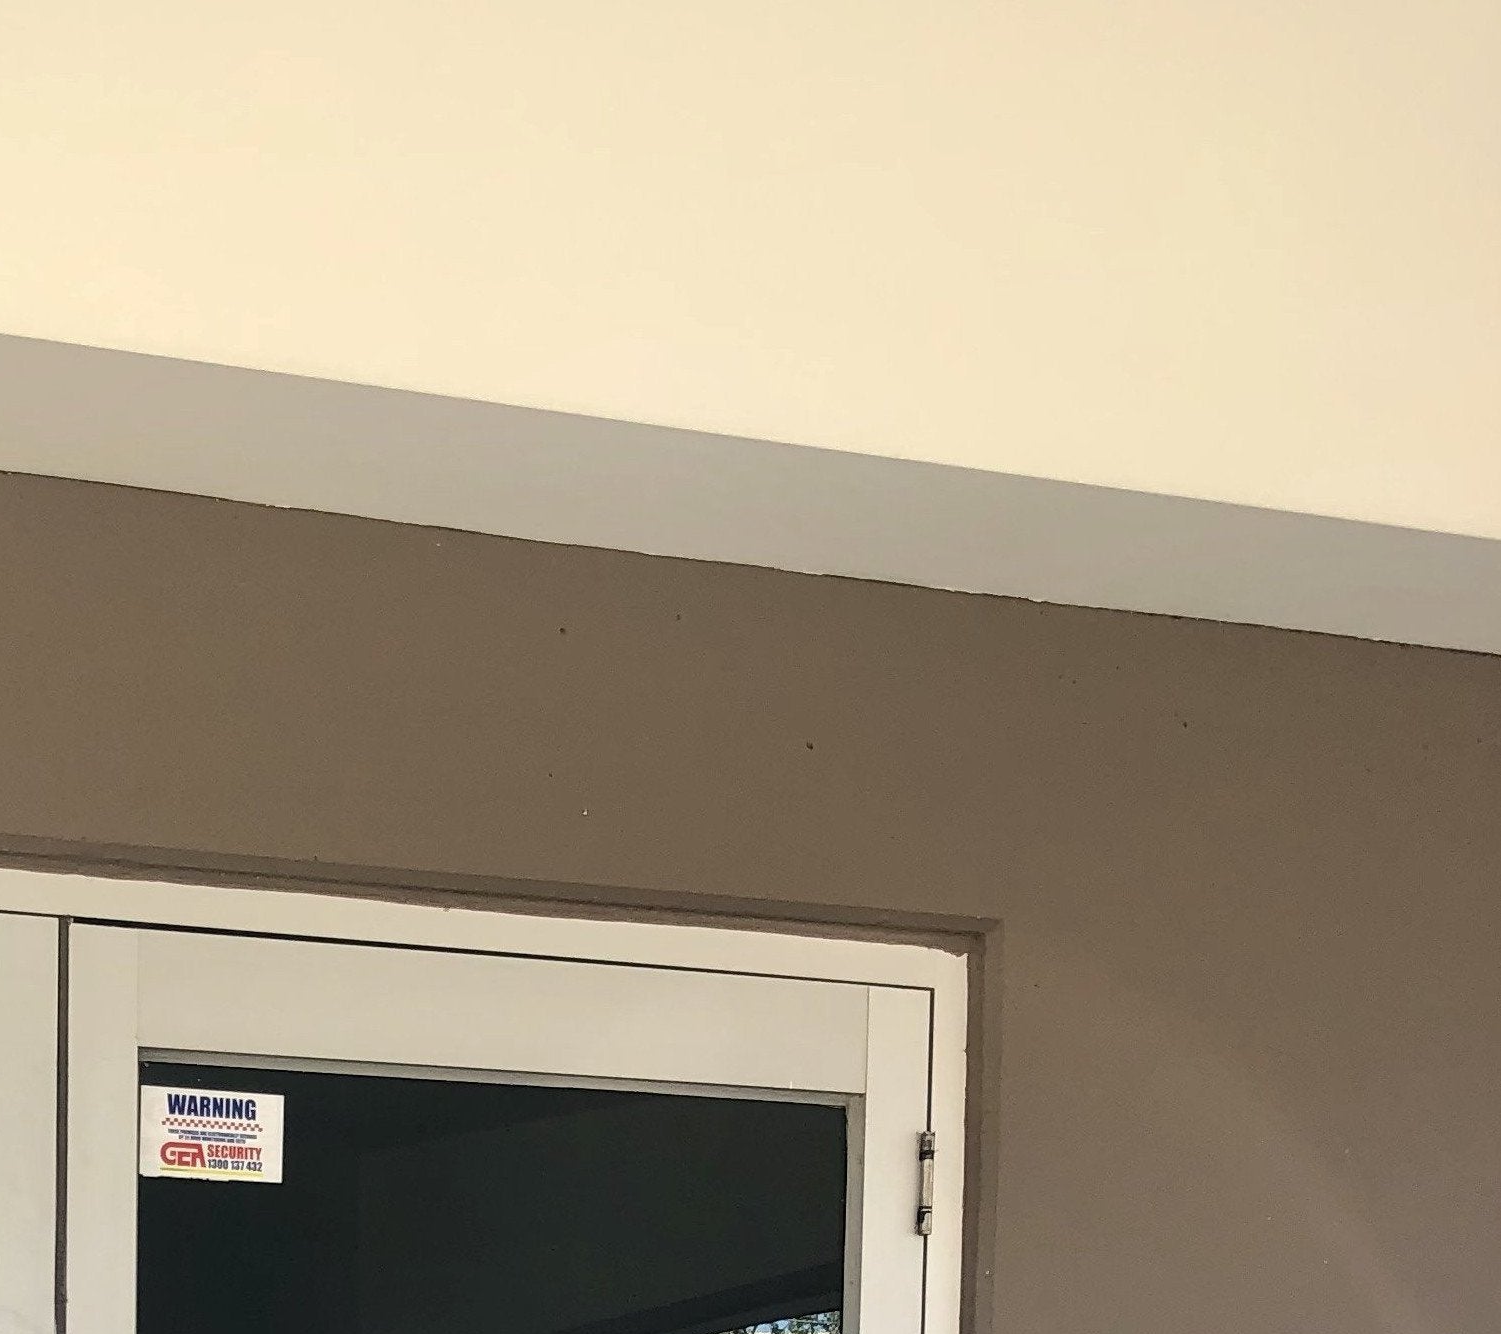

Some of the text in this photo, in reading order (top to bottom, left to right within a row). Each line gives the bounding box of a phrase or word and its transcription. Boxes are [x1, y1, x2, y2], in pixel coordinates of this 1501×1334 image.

[167, 1093, 256, 1120] WARNING
[207, 1144, 262, 1160] SECURITY
[207, 1159, 262, 1172] 1300 137 432
